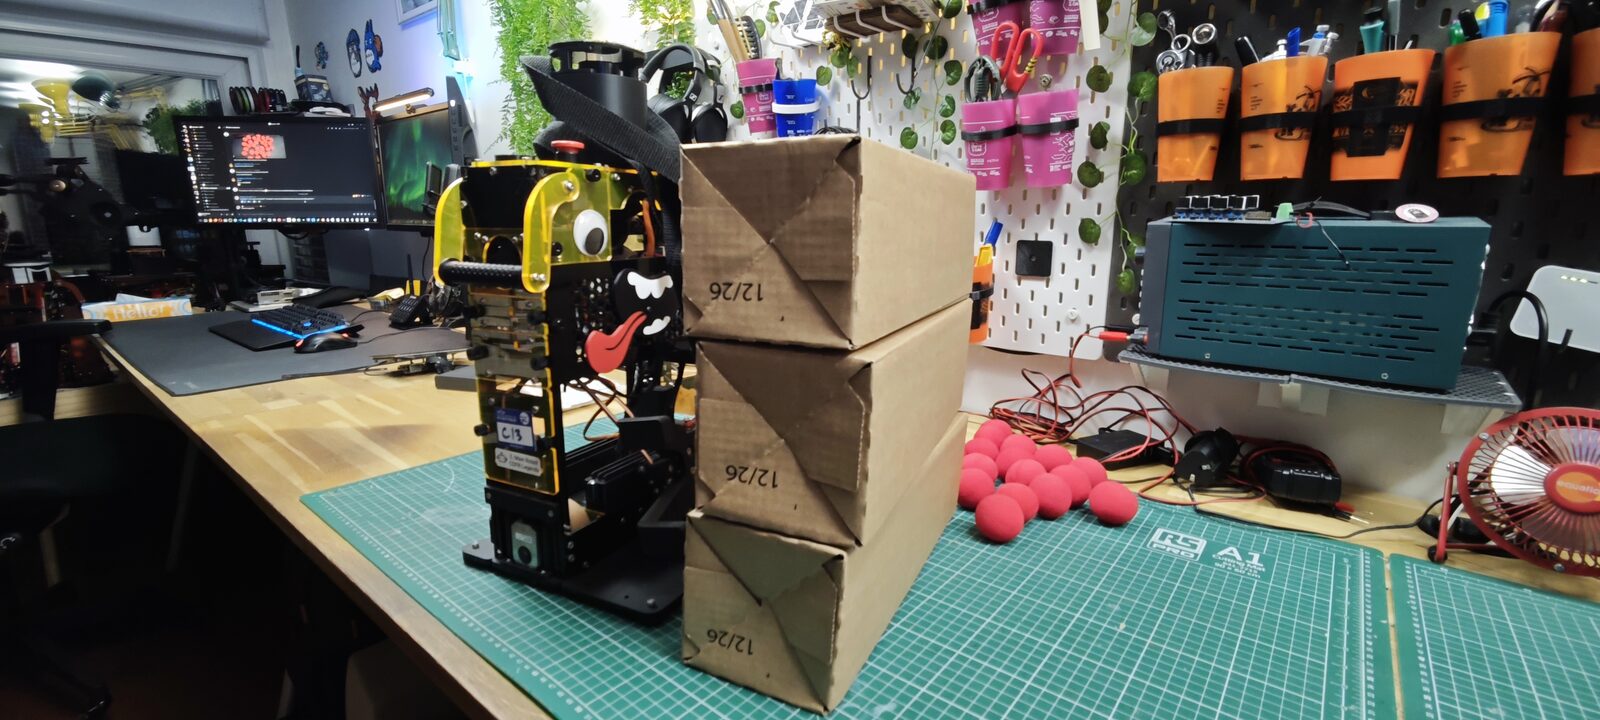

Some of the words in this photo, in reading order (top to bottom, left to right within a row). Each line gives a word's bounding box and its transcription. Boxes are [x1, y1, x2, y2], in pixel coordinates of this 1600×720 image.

[709, 282, 764, 302] 12/26
[725, 464, 778, 488] 12/26
[1152, 543, 1195, 558] PRO
[1157, 531, 1200, 552] RS
[1216, 546, 1264, 567] A1
[707, 629, 753, 655] 12/26
